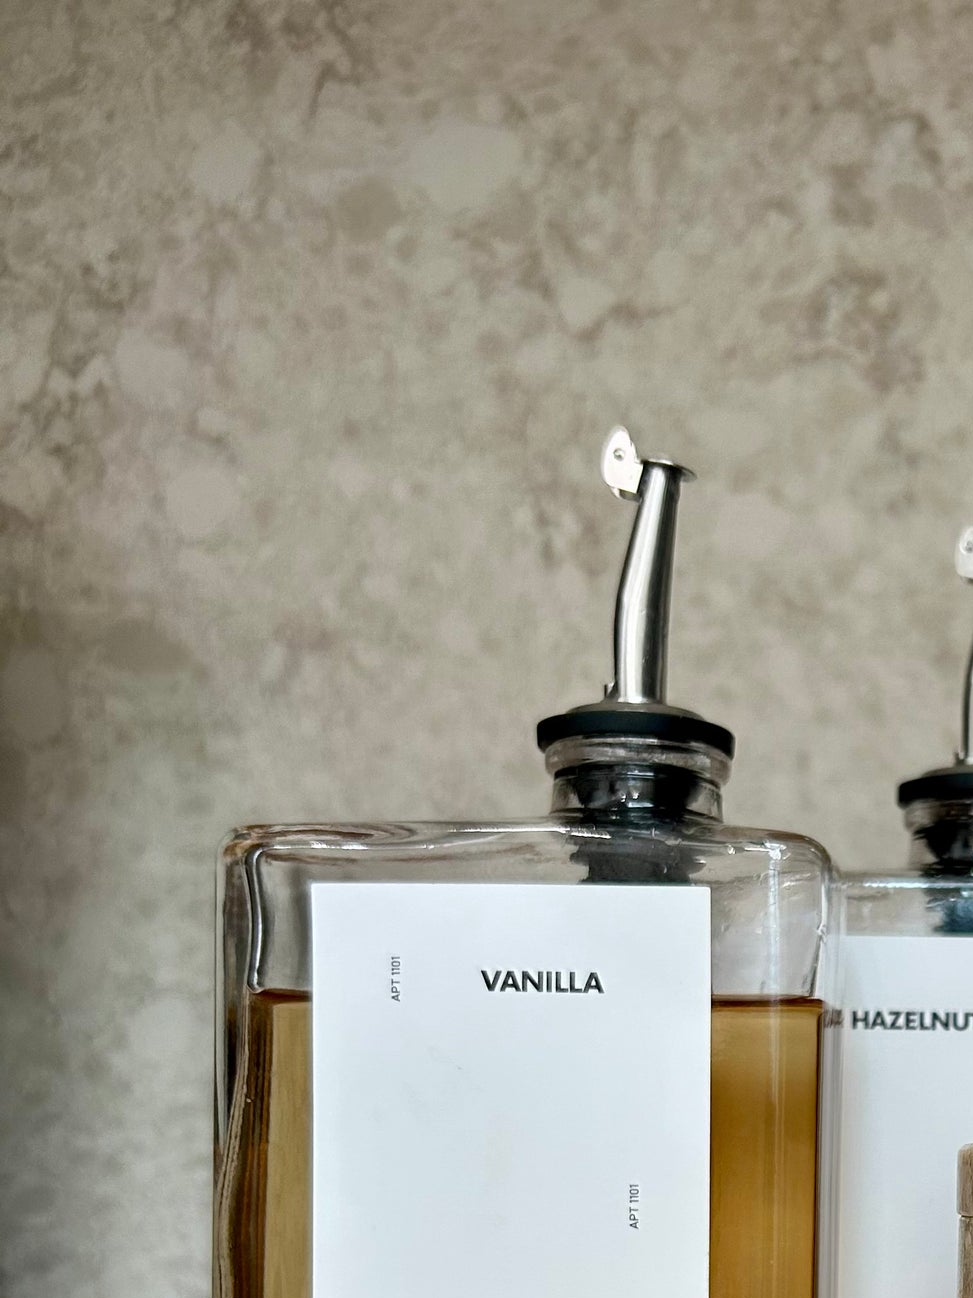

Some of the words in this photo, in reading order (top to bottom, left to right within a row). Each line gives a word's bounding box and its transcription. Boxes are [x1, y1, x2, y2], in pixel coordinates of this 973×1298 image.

[390, 956, 401, 976] 1101
[390, 978, 401, 1003] APT
[480, 969, 606, 995] VANILLA
[628, 1183, 640, 1203] 1101
[628, 1206, 640, 1230] APT
